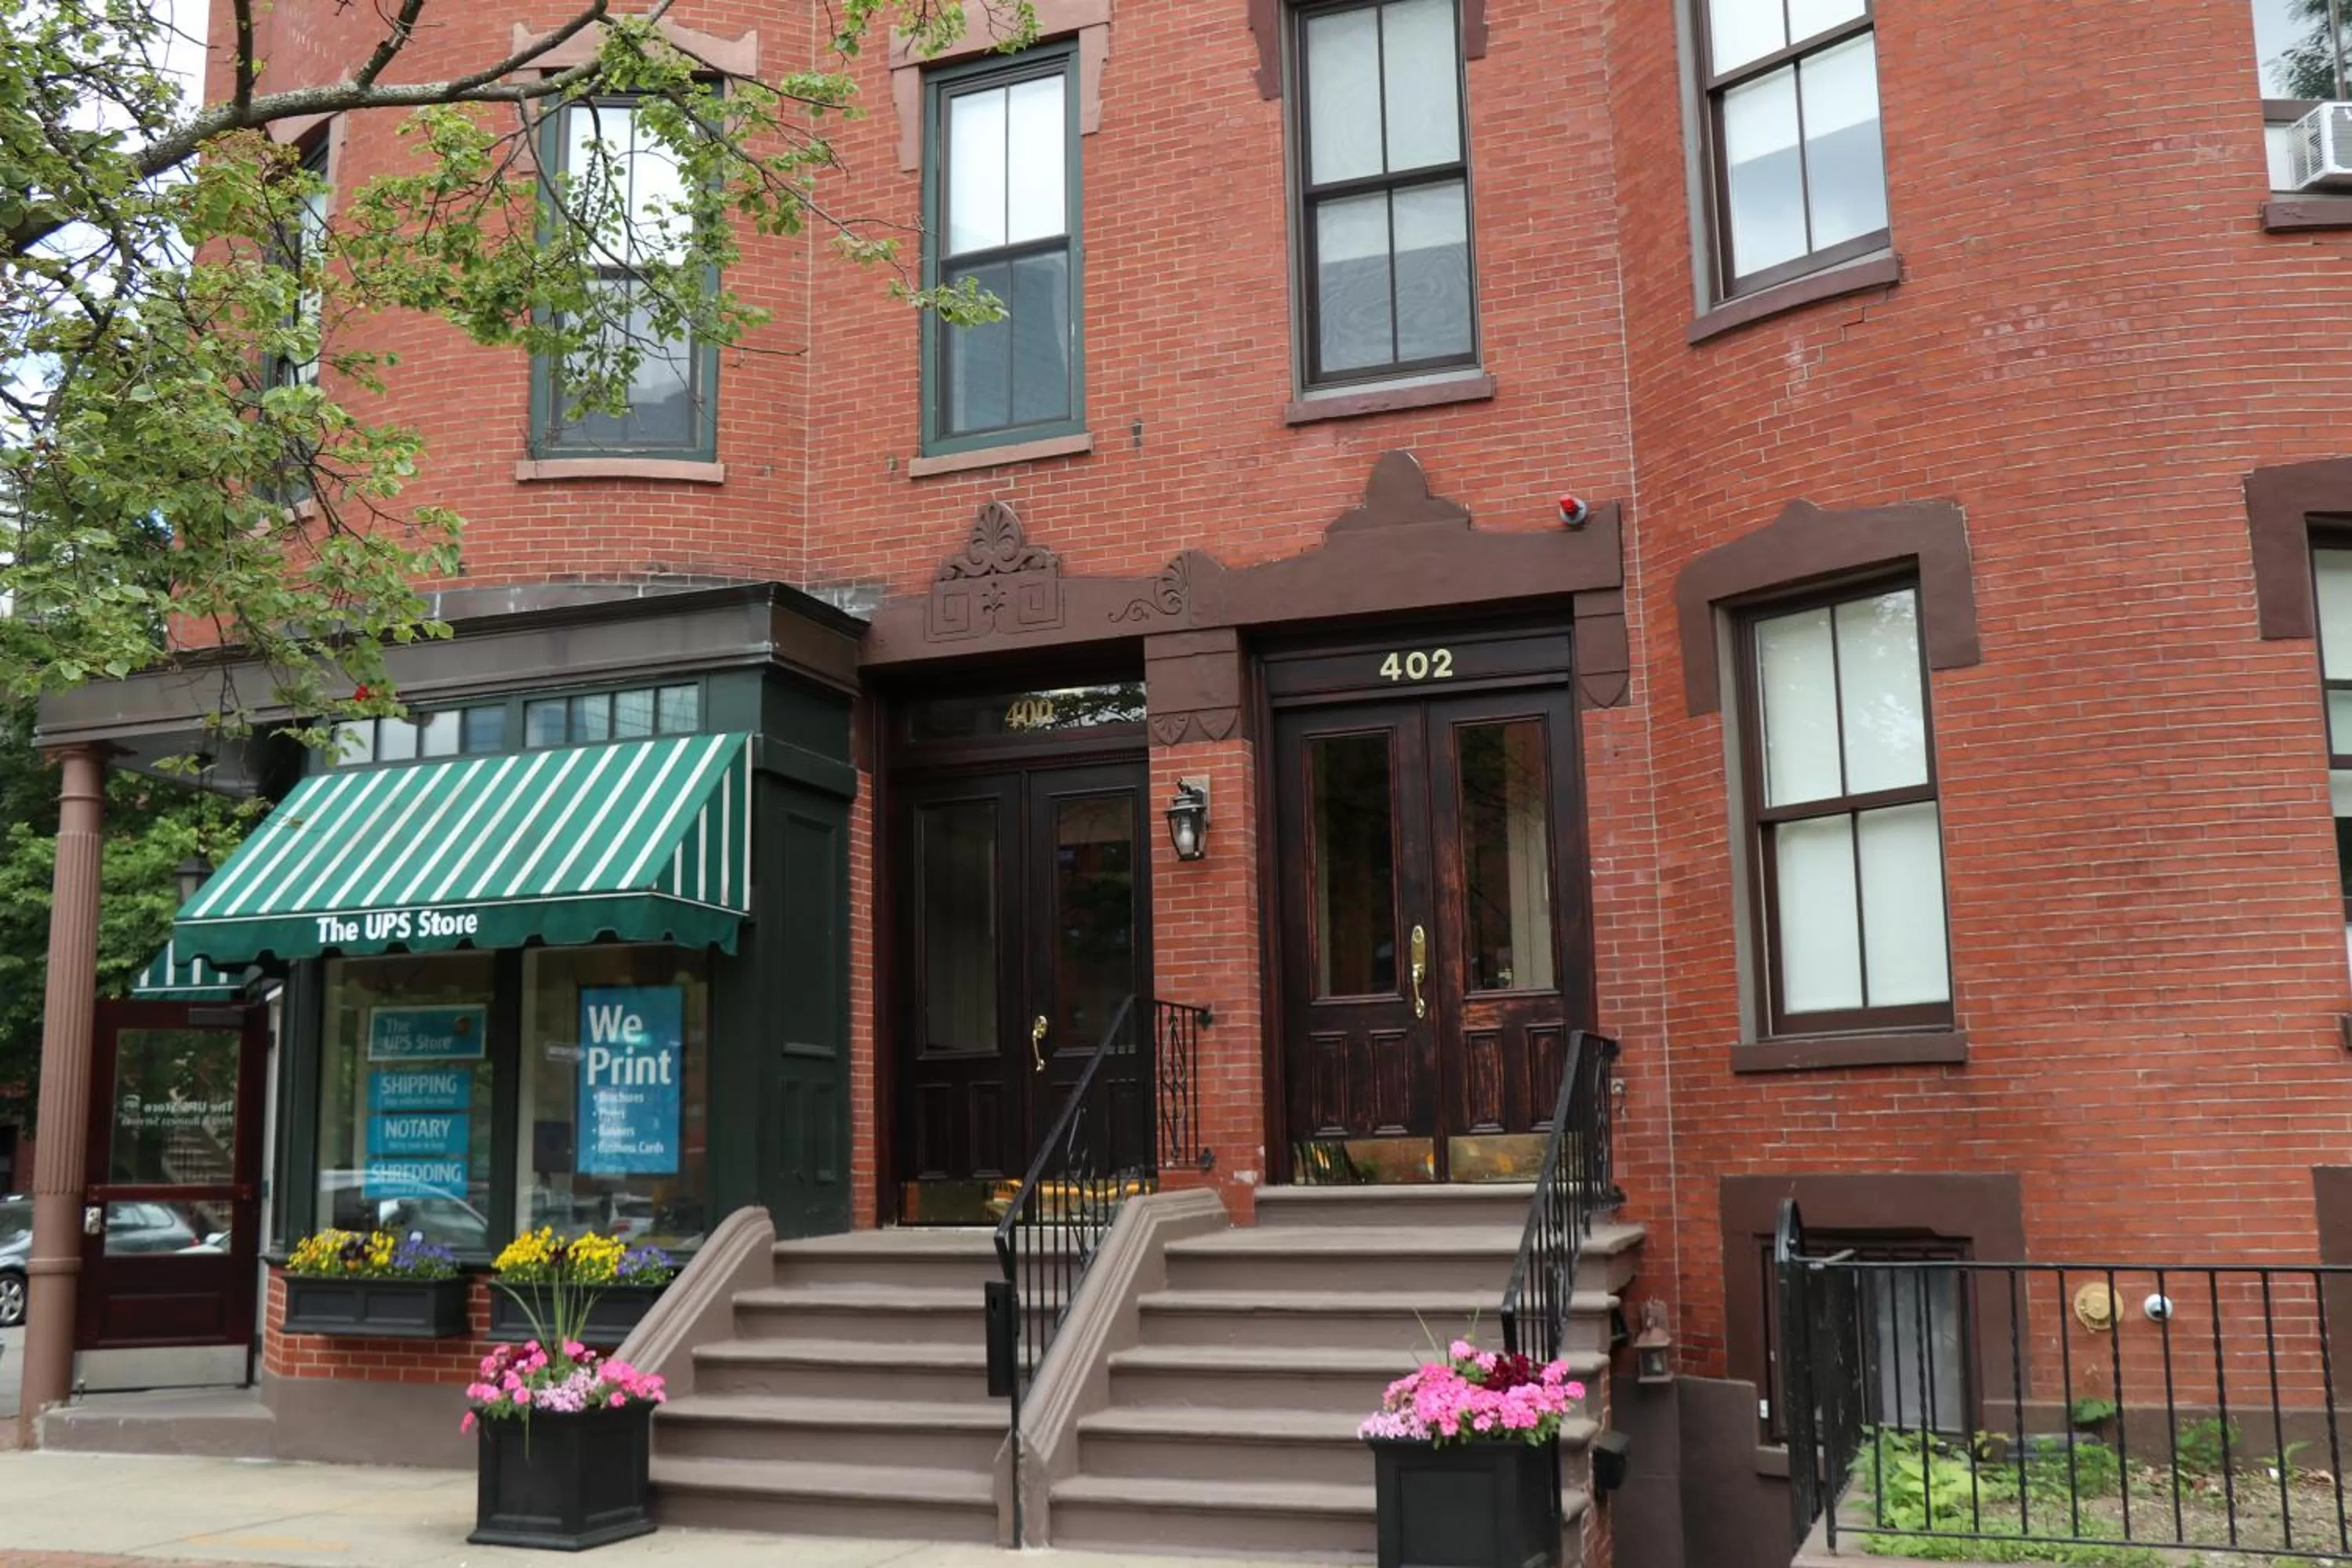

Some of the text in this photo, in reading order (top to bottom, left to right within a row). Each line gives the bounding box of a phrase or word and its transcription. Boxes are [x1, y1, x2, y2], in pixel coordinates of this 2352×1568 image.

[1380, 648, 1453, 681] 402
[1005, 699, 1054, 729] 400
[316, 909, 477, 943] The UPS Store
[384, 1017, 411, 1034] The
[587, 1004, 643, 1044] We
[382, 1033, 452, 1052] UPS Store
[587, 1046, 672, 1086] Print
[381, 1073, 458, 1095] SHIPPING
[384, 1118, 452, 1139] NOTARY
[370, 1162, 462, 1184] SHREDDING
